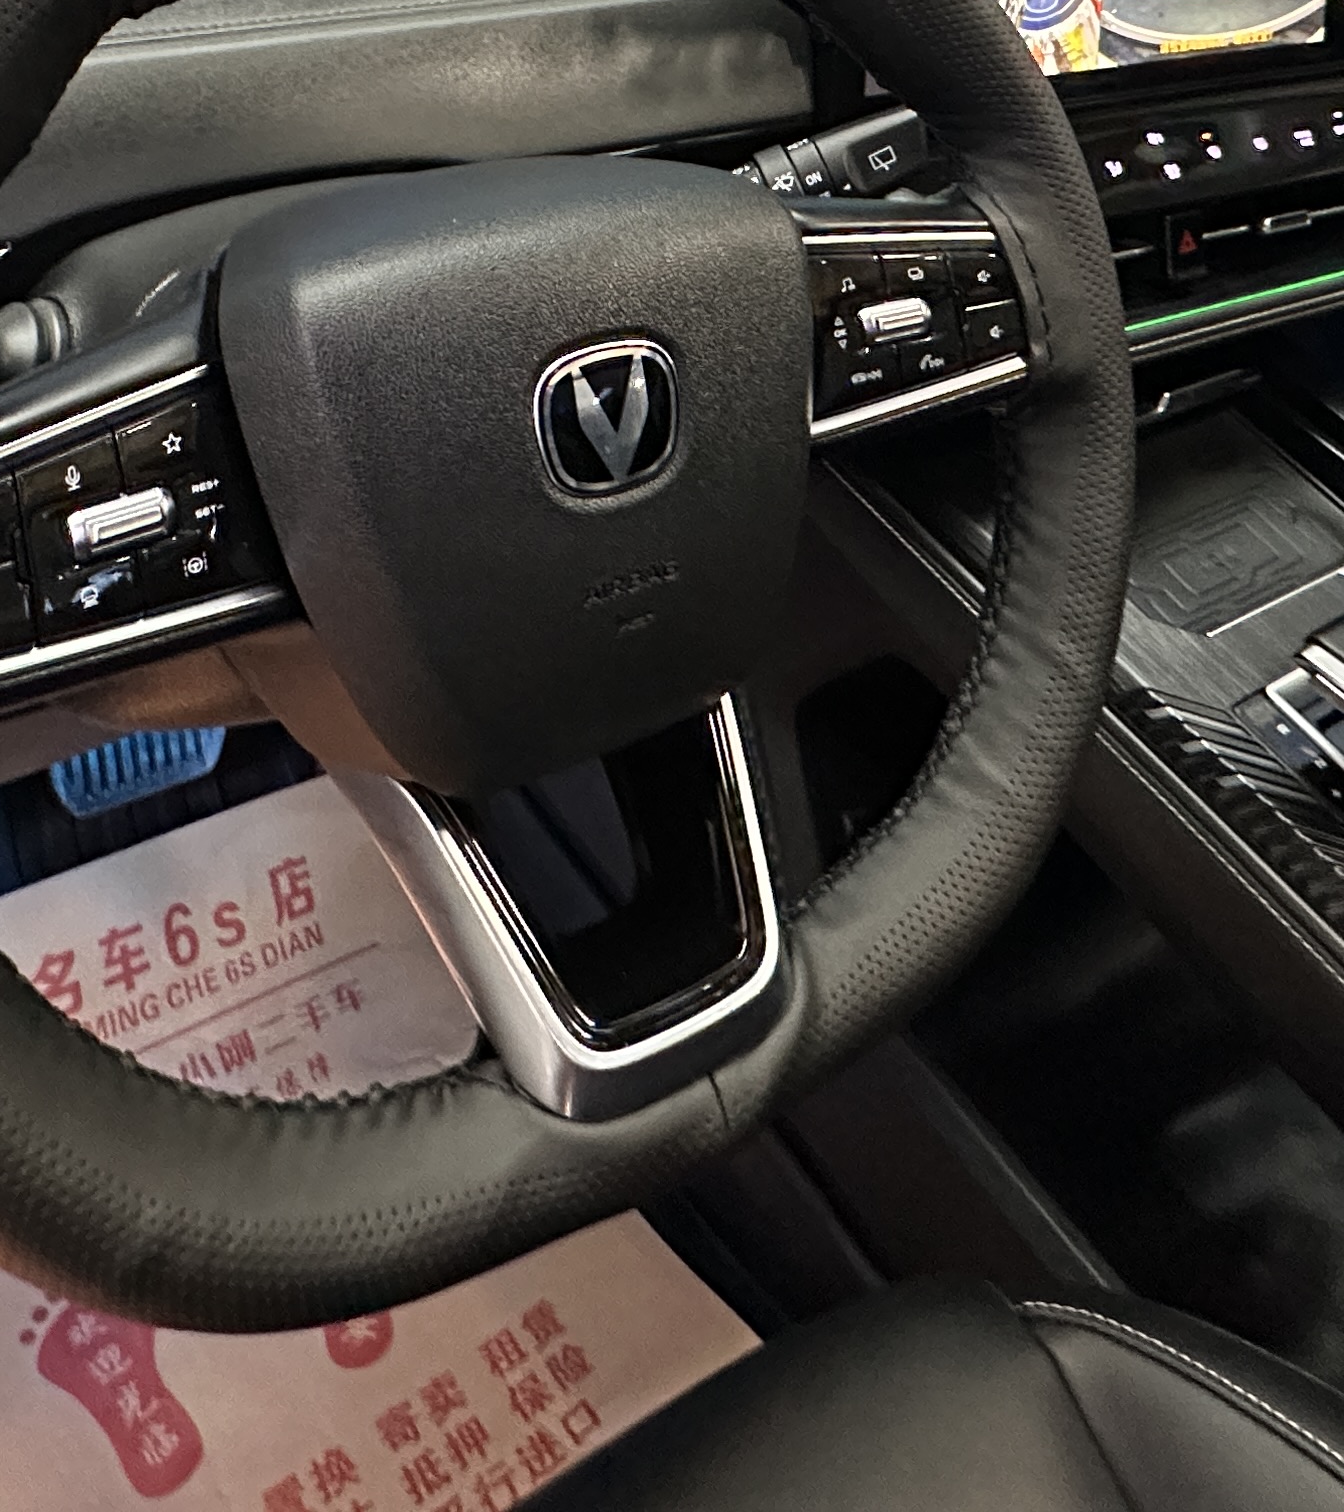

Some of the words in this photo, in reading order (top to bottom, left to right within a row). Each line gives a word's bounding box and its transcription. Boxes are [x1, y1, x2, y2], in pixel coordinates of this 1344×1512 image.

[805, 171, 823, 186] ON
[88, 993, 162, 1040] MING
[166, 967, 222, 1010] CHE
[224, 950, 257, 986] 6S
[260, 920, 325, 970] DIAN
[507, 1342, 595, 1425] 保险
